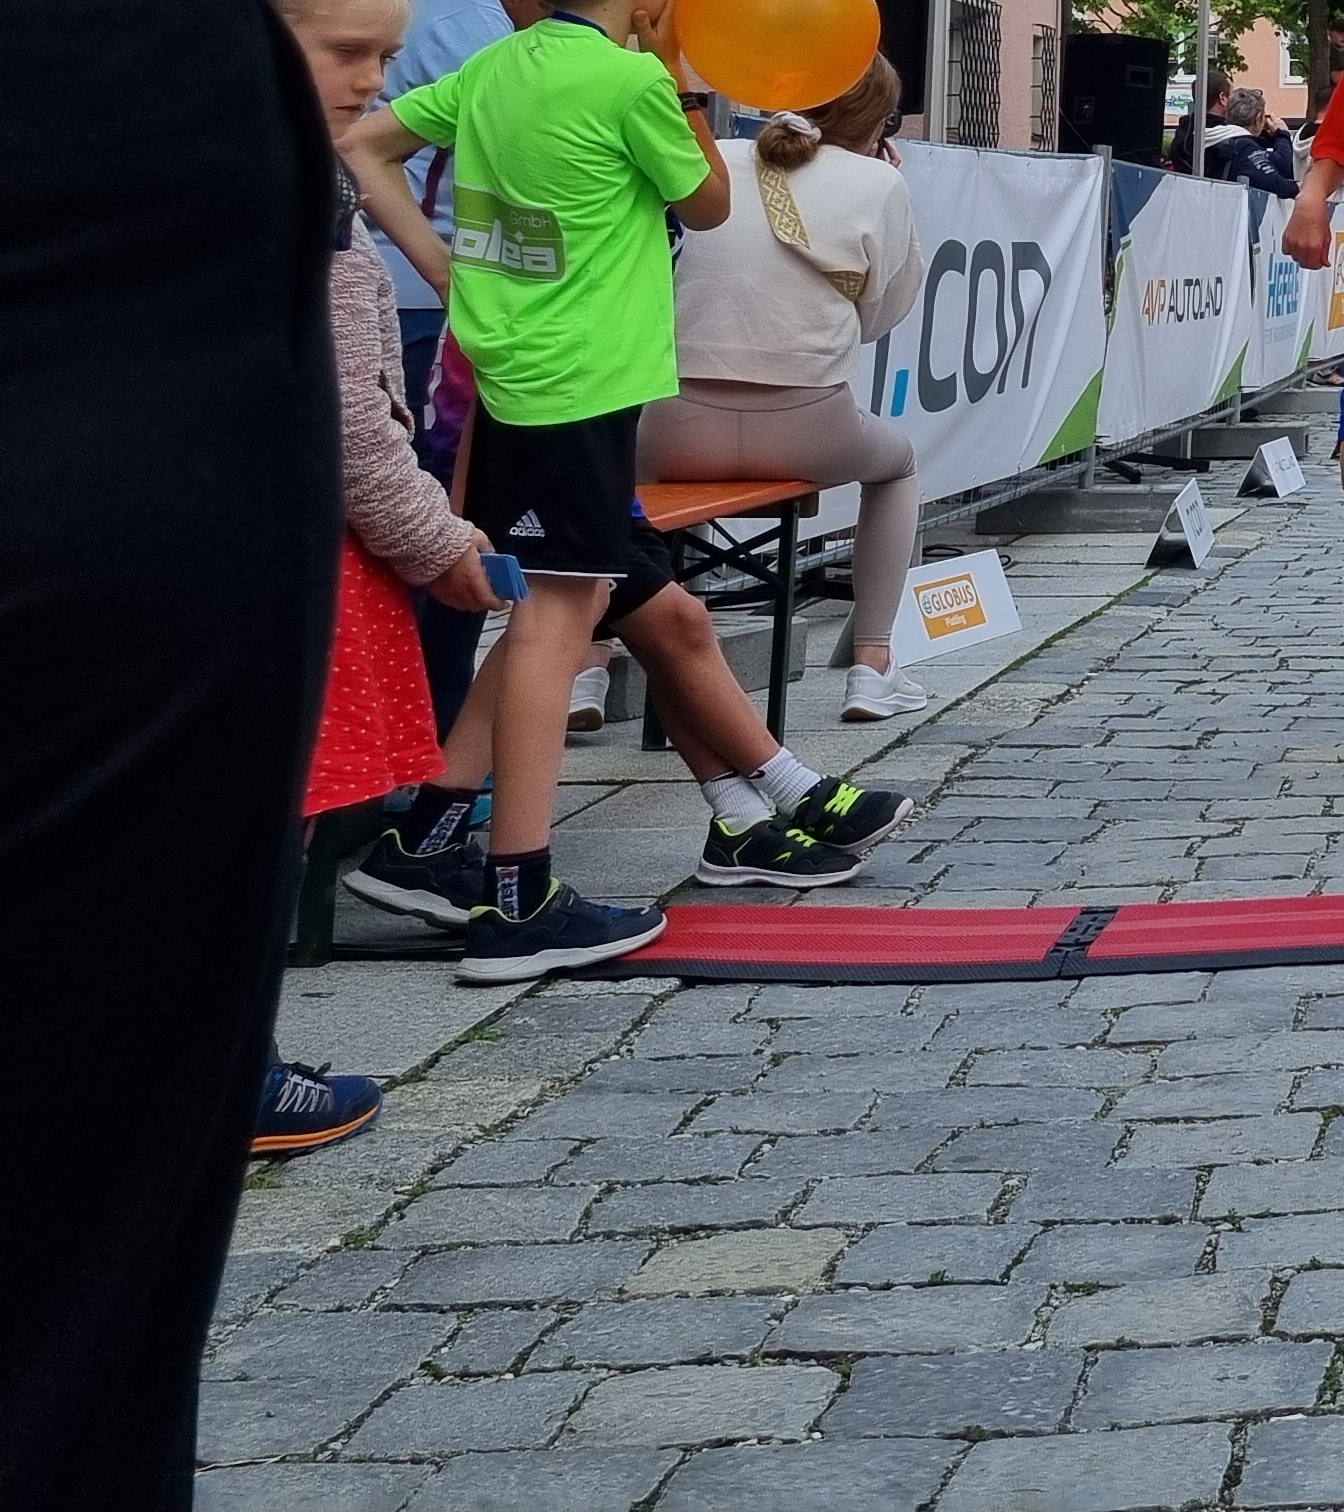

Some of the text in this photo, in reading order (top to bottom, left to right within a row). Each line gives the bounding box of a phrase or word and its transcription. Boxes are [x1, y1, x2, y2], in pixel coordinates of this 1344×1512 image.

[508, 211, 552, 228] GmbH
[452, 218, 557, 273] olea
[1141, 279, 1166, 326] AVP
[509, 526, 546, 538] adidas
[931, 584, 975, 612] GLOBUS
